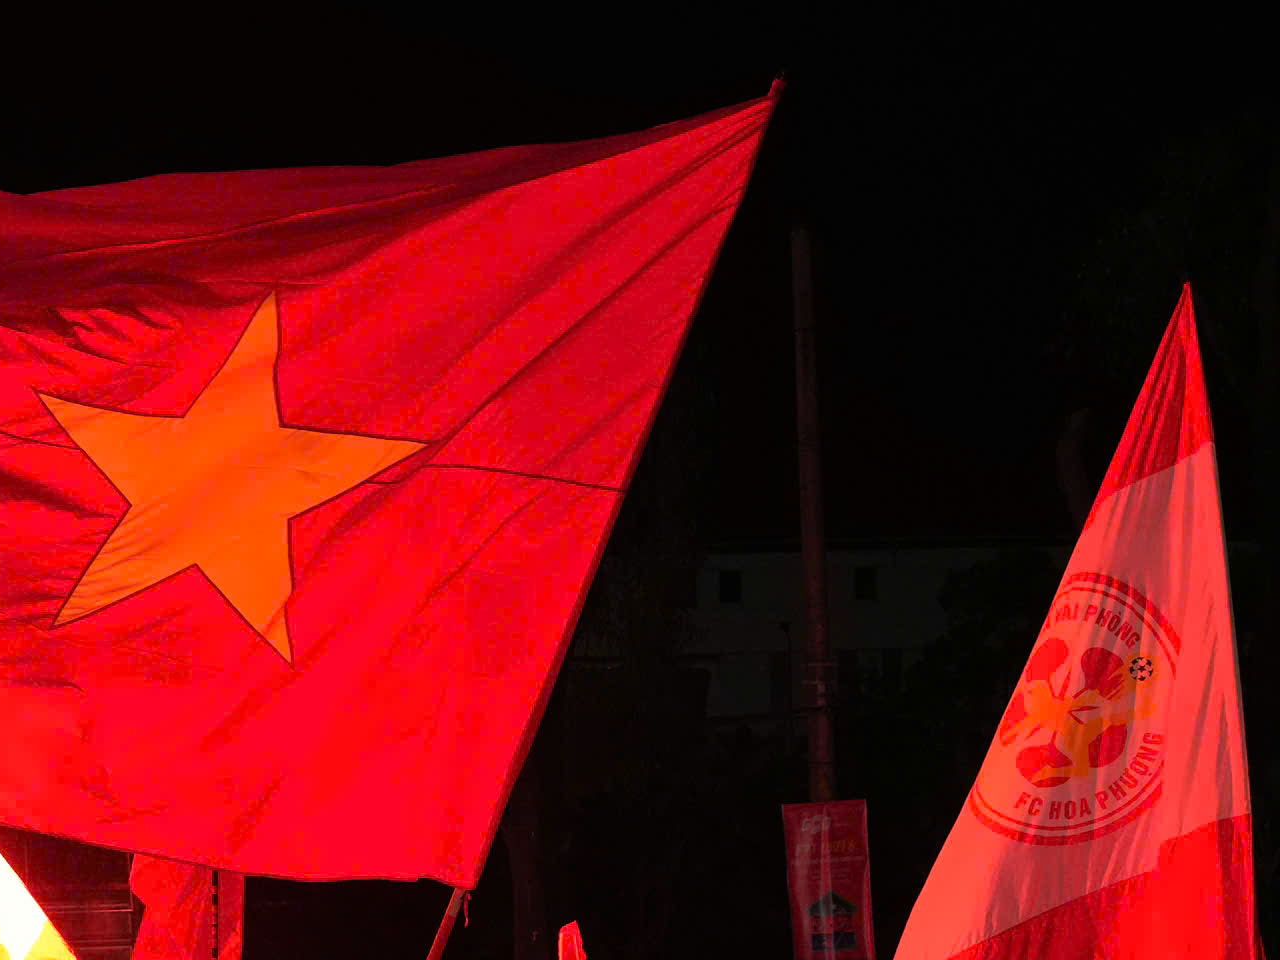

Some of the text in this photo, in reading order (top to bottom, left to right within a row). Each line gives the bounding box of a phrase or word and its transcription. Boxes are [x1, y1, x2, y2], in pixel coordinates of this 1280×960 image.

[1084, 604, 1141, 648] PHÒNG
[1013, 791, 1042, 816] FC
[1048, 800, 1092, 820] HOA
